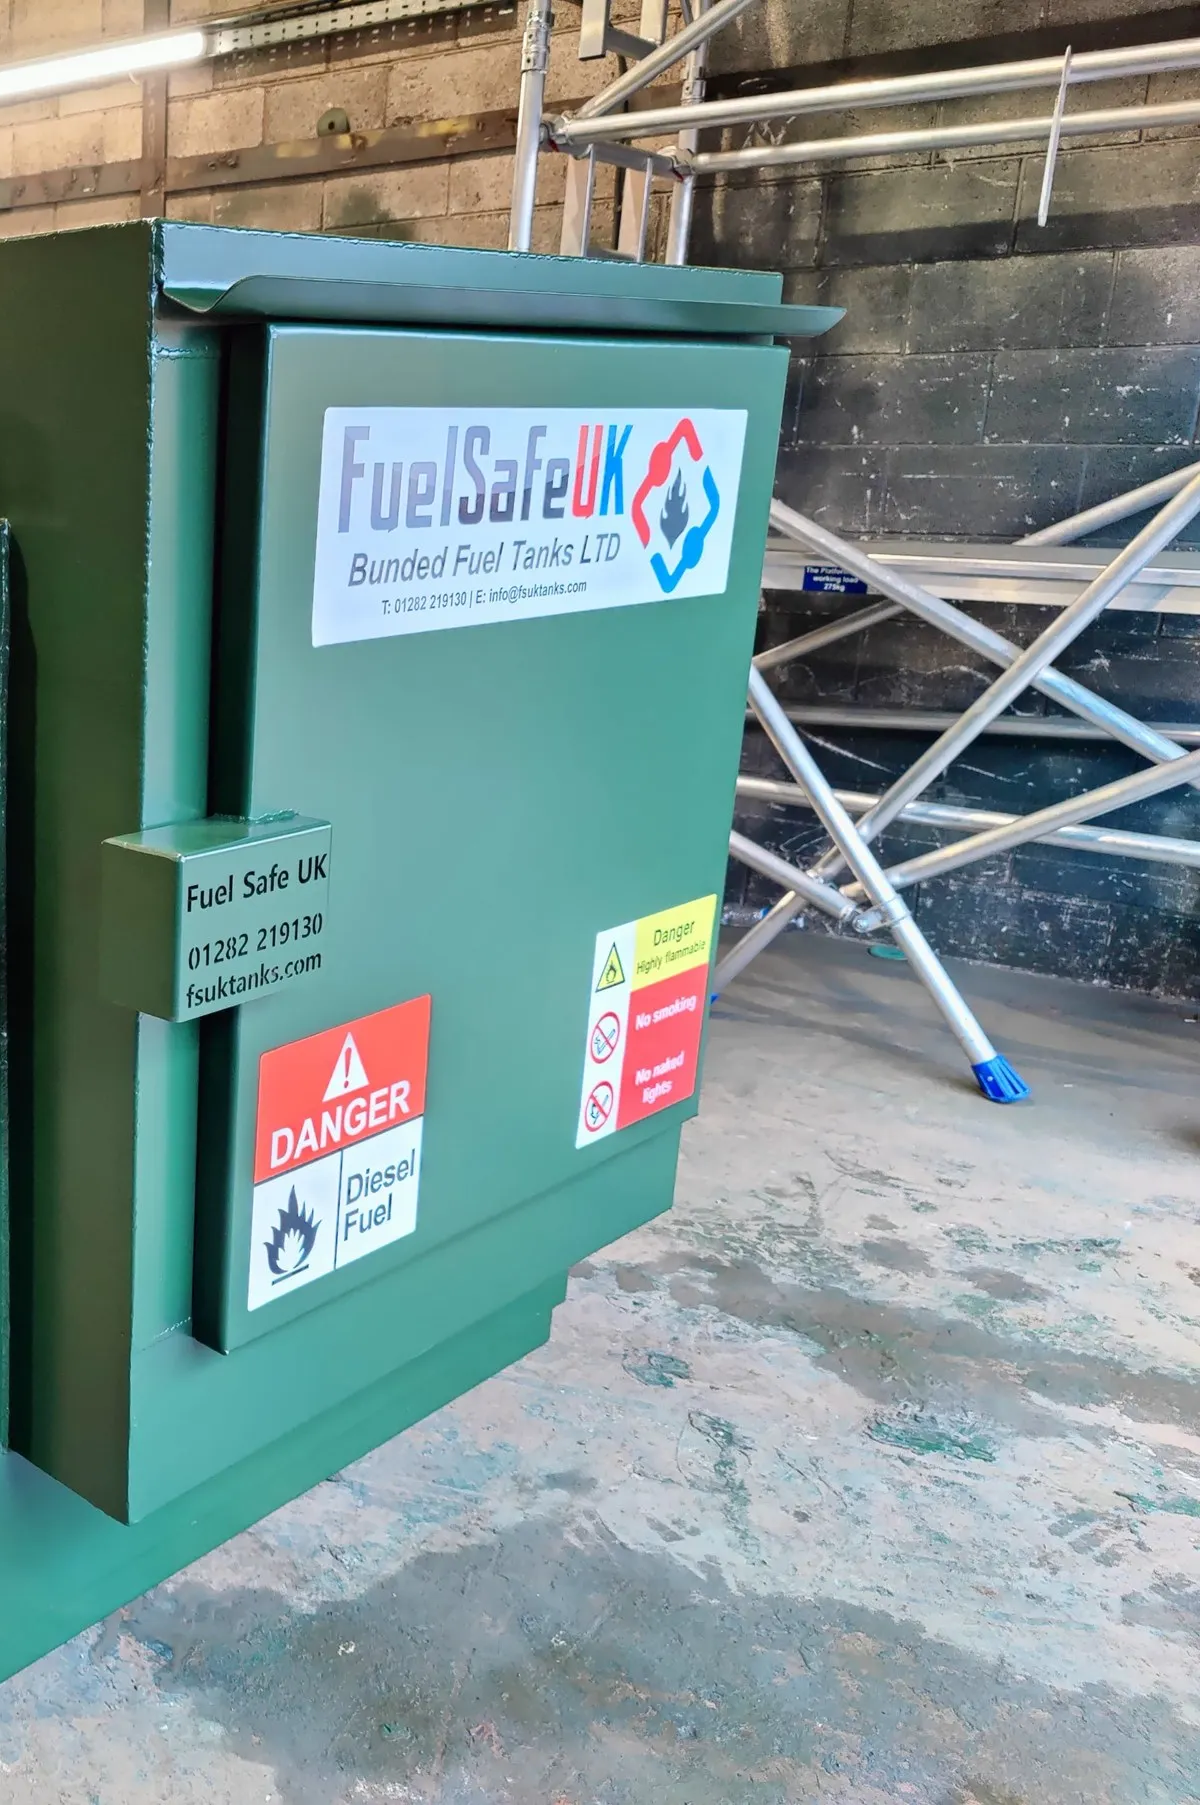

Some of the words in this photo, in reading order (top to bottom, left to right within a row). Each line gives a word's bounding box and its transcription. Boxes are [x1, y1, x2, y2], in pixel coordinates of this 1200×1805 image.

[337, 424, 634, 533] FuelSafeUK
[347, 545, 447, 587] Bunded
[452, 542, 505, 577] Fuel
[511, 536, 574, 572] Tanks
[579, 532, 621, 564] LTD
[812, 575, 842, 584] working
[382, 600, 391, 615] T:
[394, 596, 427, 613] 01282
[429, 592, 467, 609] 219130
[475, 590, 486, 604] E:
[489, 581, 587, 603] info@fsuktanks.com
[187, 874, 233, 912] Fuel
[243, 863, 289, 898] Safe
[298, 853, 327, 884] UK
[188, 933, 249, 970] 01282
[257, 912, 323, 951] 219130
[636, 955, 663, 974] Highly
[665, 940, 706, 963] flammable
[653, 920, 695, 947] Danger
[186, 952, 322, 1008] fsuktanks.com
[635, 1012, 651, 1030] No
[653, 995, 697, 1020] smoking
[635, 1067, 651, 1085] No
[653, 1051, 684, 1075] naked
[642, 1079, 673, 1104] lights
[270, 1079, 411, 1169] DANGER
[346, 1148, 416, 1205] Diesel
[343, 1194, 393, 1241] Fuel
